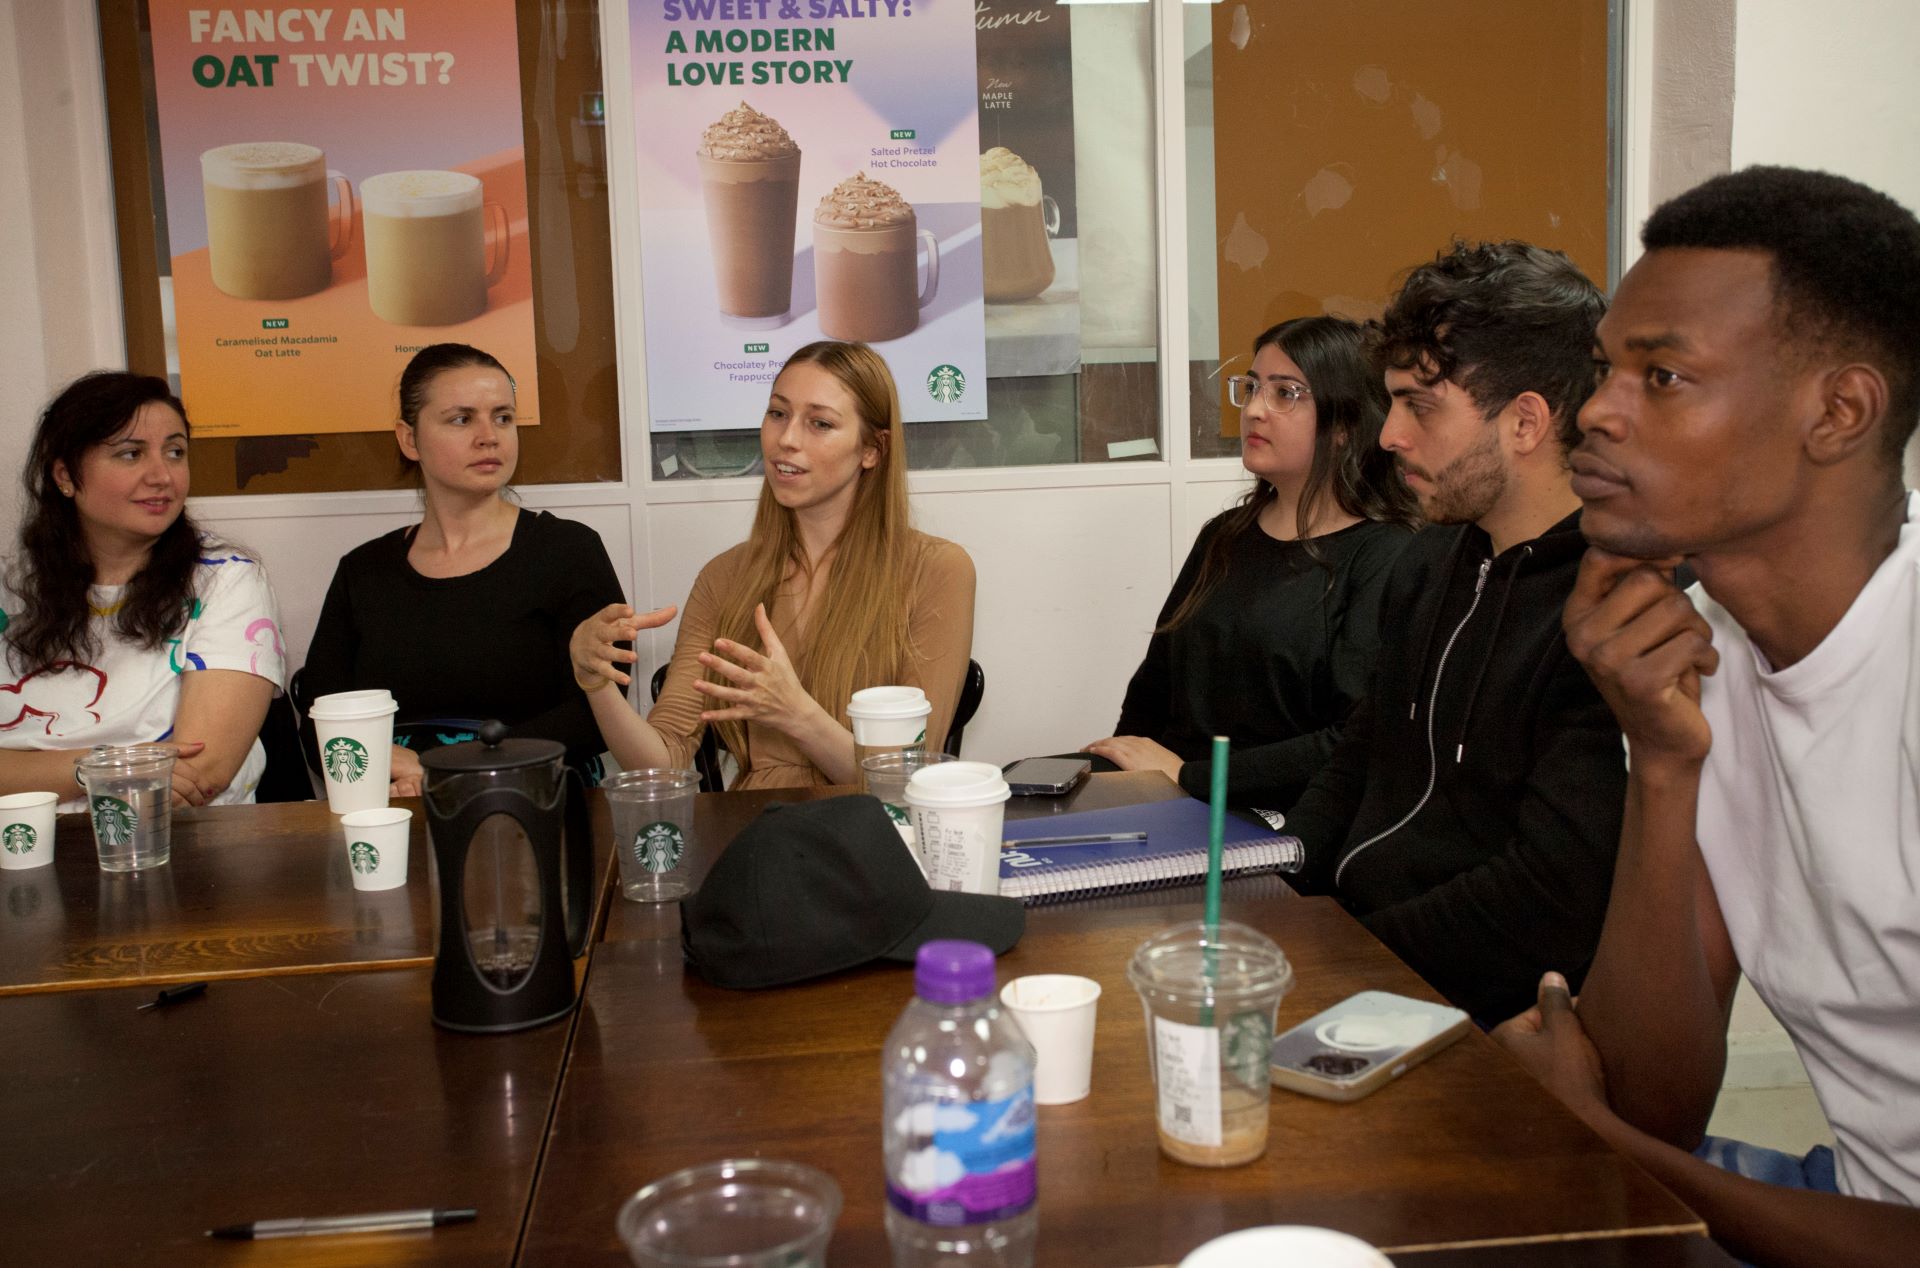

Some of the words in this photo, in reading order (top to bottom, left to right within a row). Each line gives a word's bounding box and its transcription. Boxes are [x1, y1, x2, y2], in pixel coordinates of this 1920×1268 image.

[663, 0, 771, 21] SWEET
[778, 0, 803, 20] &
[808, 0, 912, 19] SALTY:
[188, 9, 334, 43] FANCY
[343, 8, 406, 41] AN
[665, 29, 688, 53] A
[695, 27, 835, 53] MODERN
[192, 54, 280, 89] OAT
[289, 51, 455, 87] TWIST?
[667, 61, 744, 86] LOVE
[751, 59, 854, 84] STORY
[985, 78, 1013, 90] New
[982, 92, 1013, 101] MAPLE
[985, 101, 1012, 109] LATTE
[871, 147, 901, 156] Salted
[903, 146, 936, 156] Pretzel
[871, 160, 888, 168] Hot
[890, 159, 937, 168] Chocolate
[265, 320, 286, 328] NEW
[215, 337, 278, 347] Caramelised
[280, 335, 338, 345] Macadamia
[255, 348, 273, 358] Oat
[275, 348, 302, 357] Latte
[713, 360, 766, 370] Chocolatey
[768, 360, 788, 368] Pre
